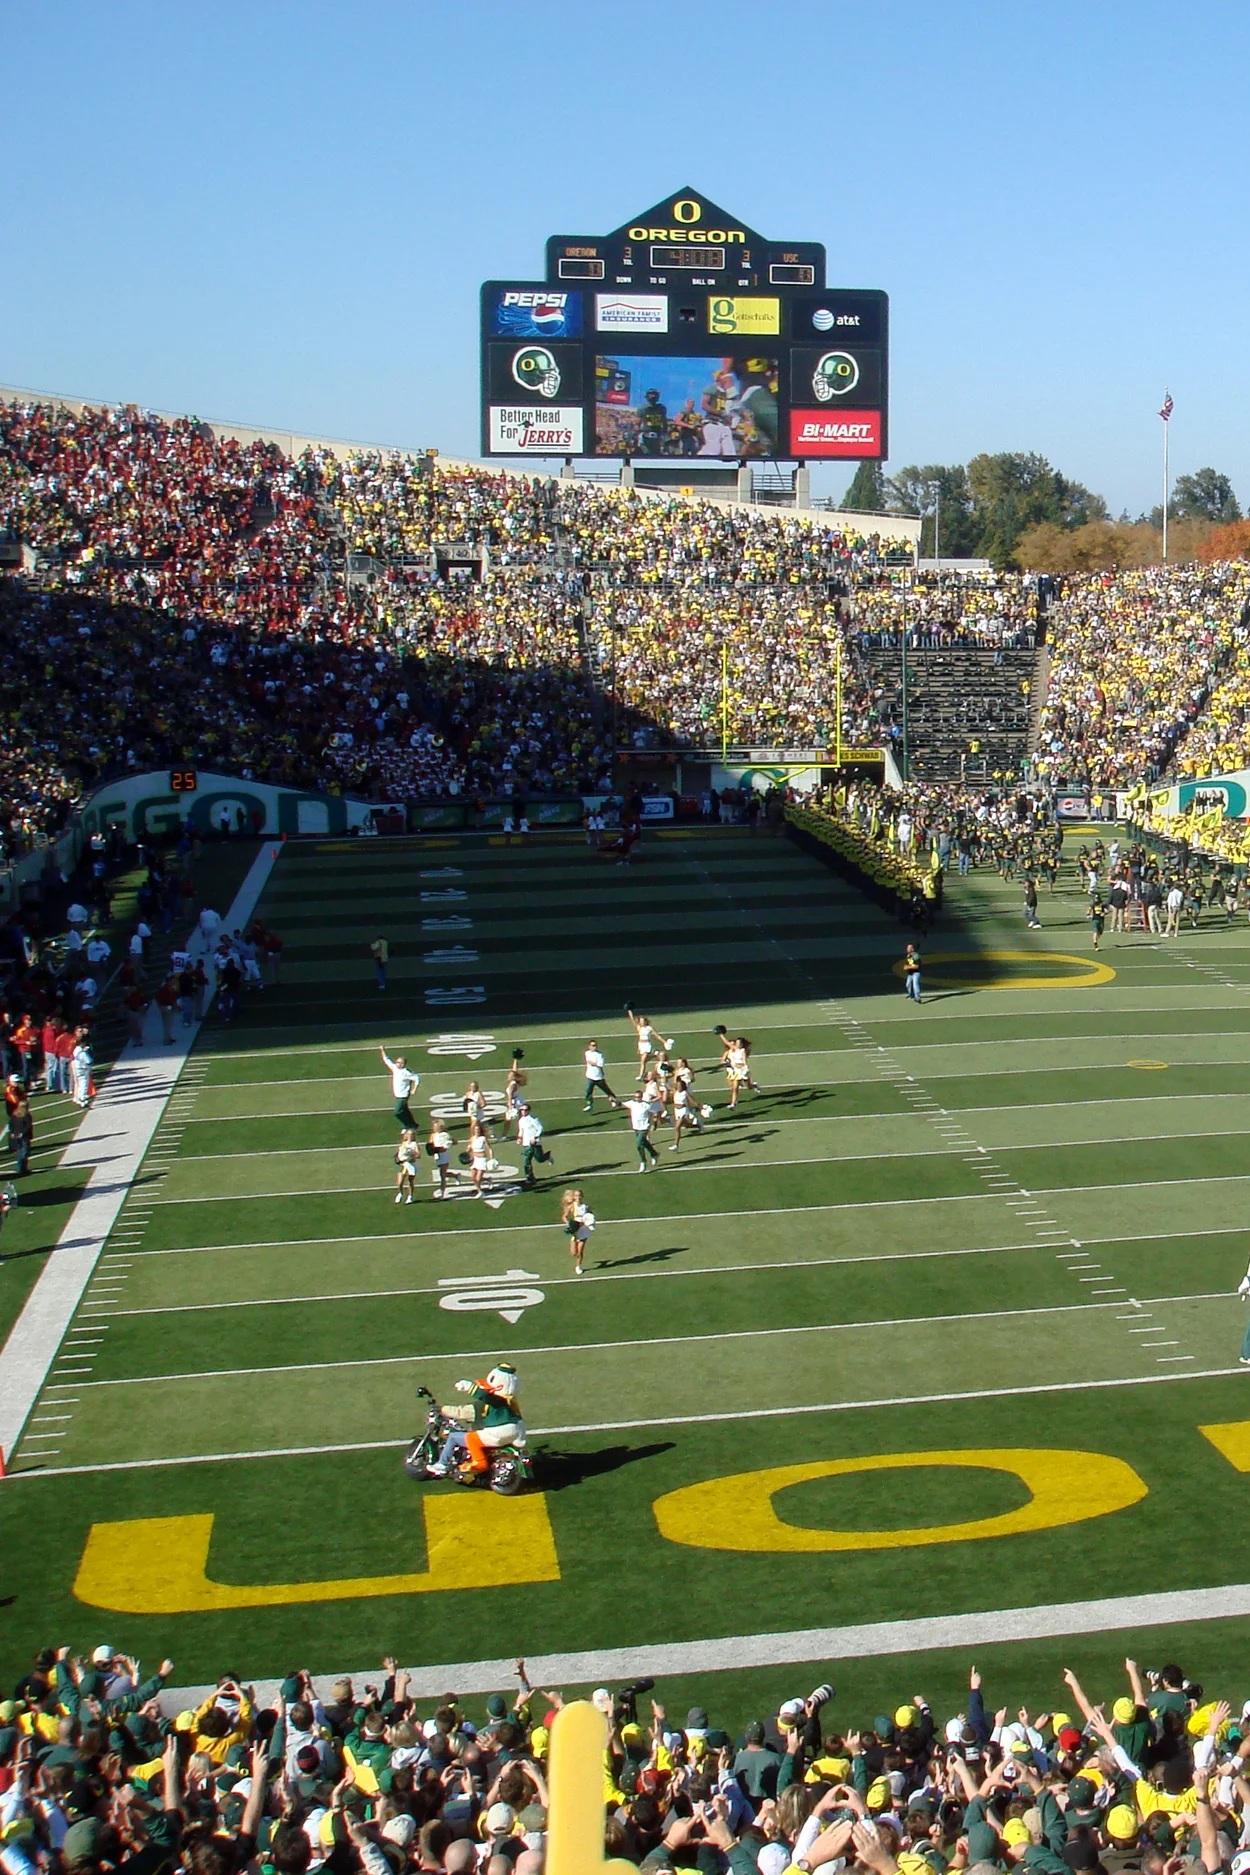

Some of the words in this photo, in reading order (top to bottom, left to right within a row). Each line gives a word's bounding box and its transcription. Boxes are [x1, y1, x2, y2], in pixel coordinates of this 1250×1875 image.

[674, 200, 701, 223] O
[628, 227, 746, 243] OREGON
[565, 247, 597, 257] OREGON
[783, 253, 799, 263] USC
[503, 293, 568, 308] PEPSI
[836, 314, 860, 326] at&t
[500, 409, 533, 423] Better
[535, 410, 561, 423] Head
[500, 425, 519, 439] For
[518, 427, 573, 448] JERRY'S
[171, 772, 196, 791] 25
[437, 1268, 546, 1311] 10
